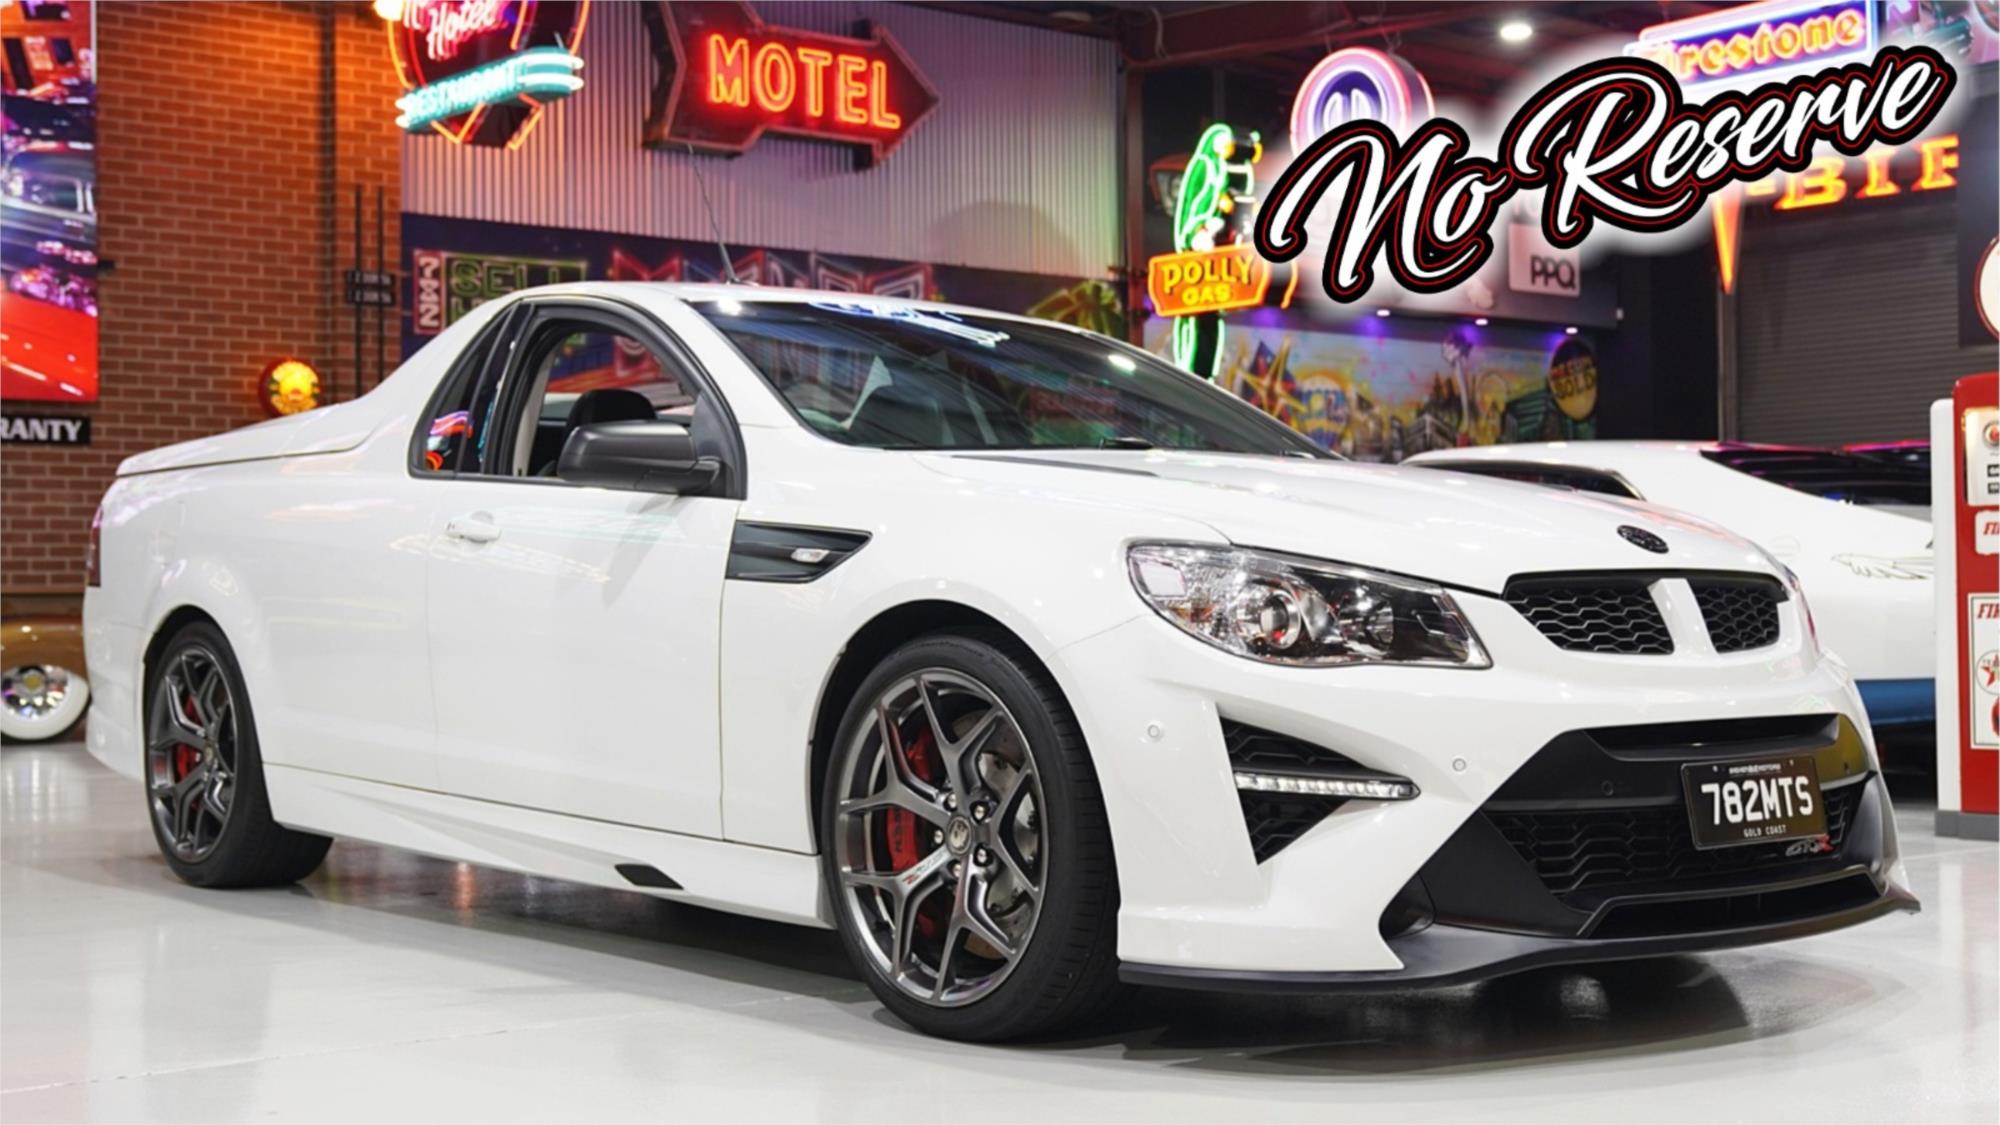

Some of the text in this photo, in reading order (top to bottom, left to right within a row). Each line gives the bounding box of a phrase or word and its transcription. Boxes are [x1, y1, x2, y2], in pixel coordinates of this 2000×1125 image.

[709, 33, 901, 129] MOTEL
[1161, 254, 1254, 294] POLLY
[1530, 254, 1576, 290] PPQ
[1182, 282, 1231, 305] GAS
[1701, 775, 1813, 826] 782MTS
[1743, 824, 1787, 838] GOLD COAST
